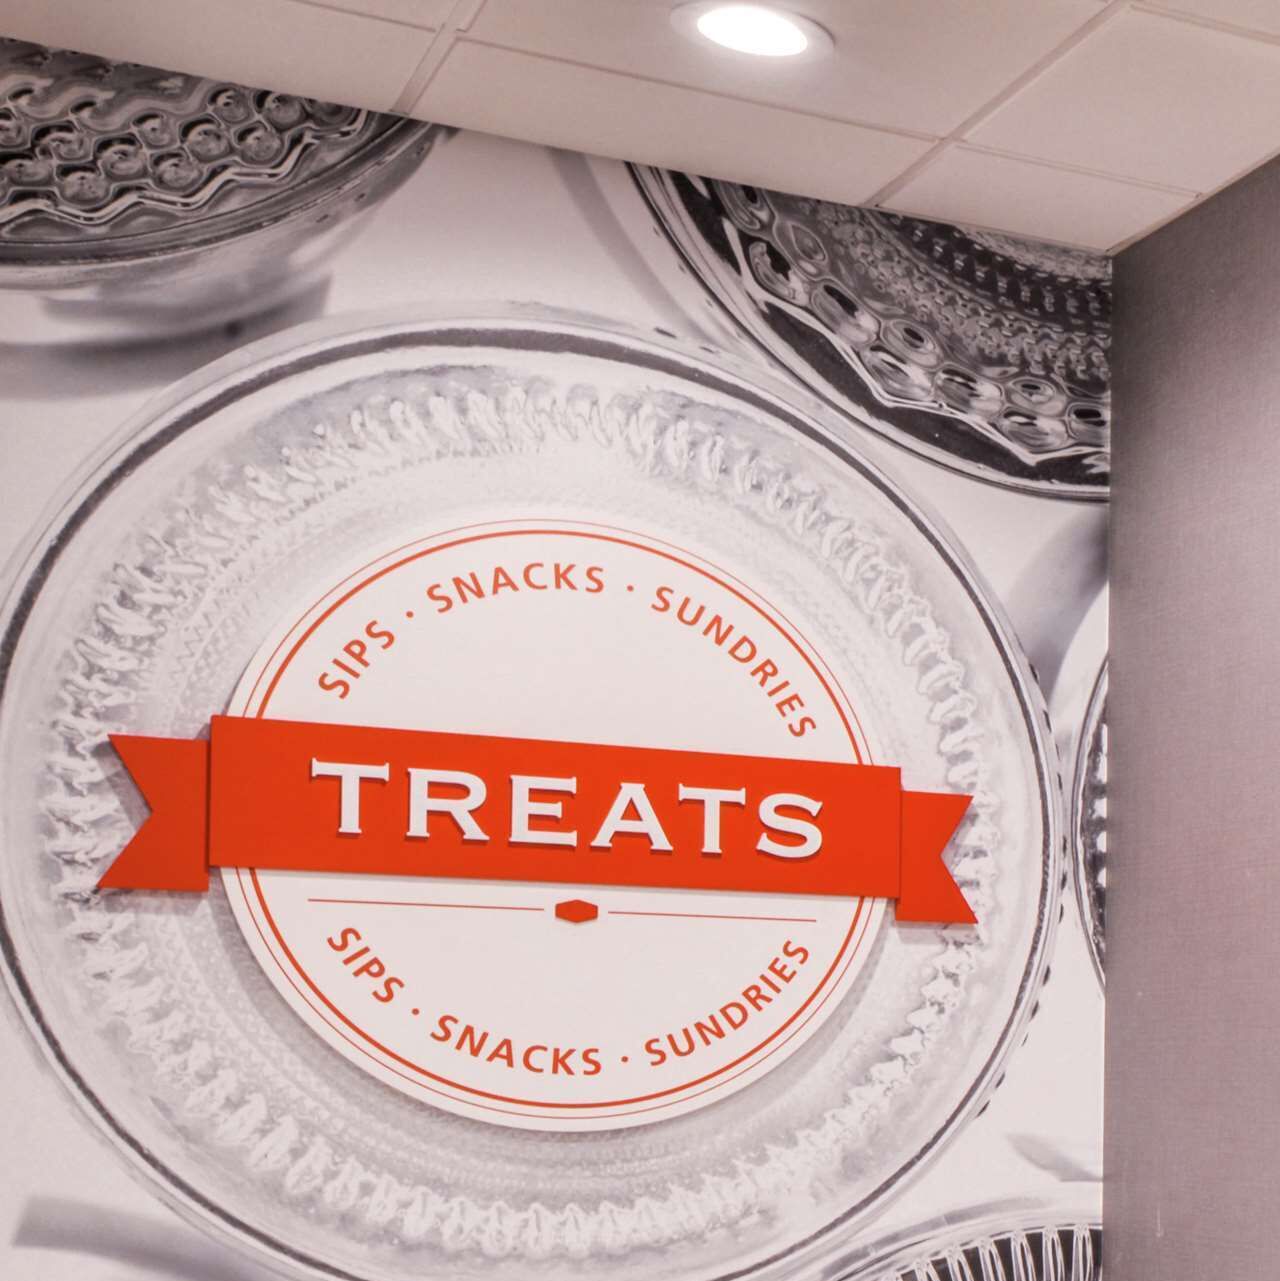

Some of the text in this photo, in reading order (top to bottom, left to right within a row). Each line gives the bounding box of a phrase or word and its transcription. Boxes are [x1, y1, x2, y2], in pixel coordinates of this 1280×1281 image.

[318, 562, 816, 739] SIPS SNACKS SUNDRIES
[310, 757, 825, 861] TREATS
[328, 928, 810, 1077] SIPS SNACKS SUNDRIES
